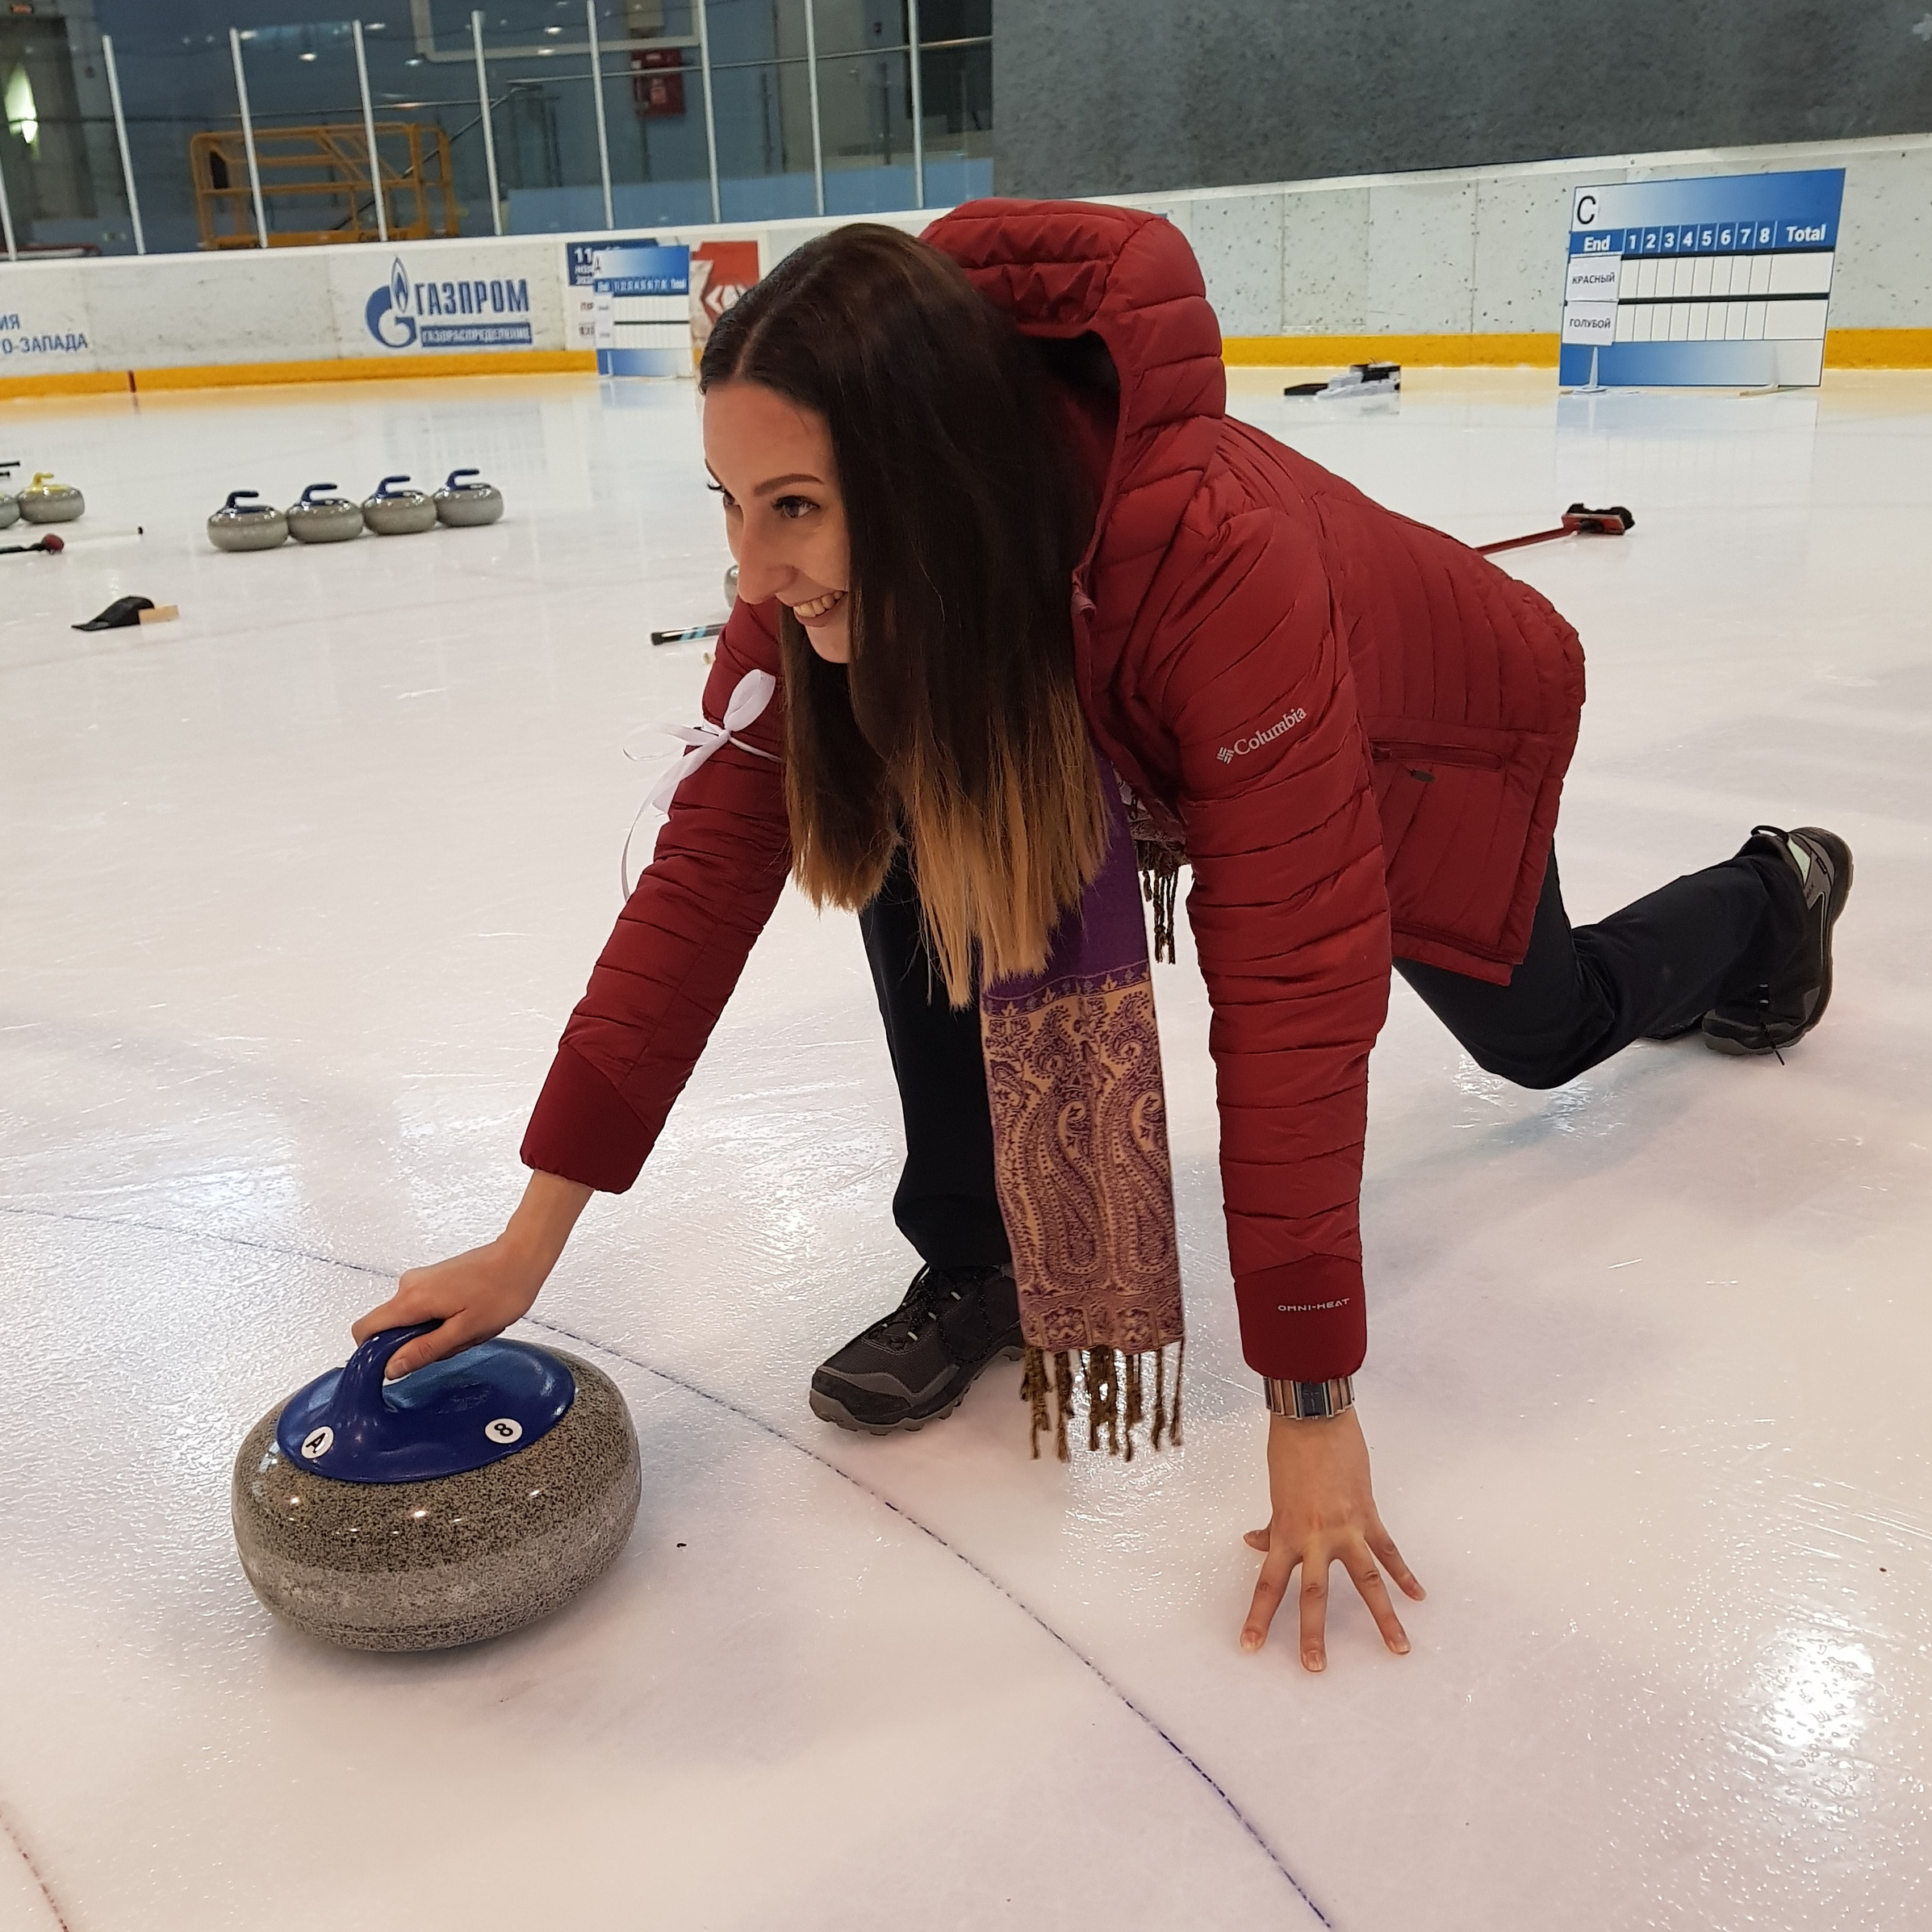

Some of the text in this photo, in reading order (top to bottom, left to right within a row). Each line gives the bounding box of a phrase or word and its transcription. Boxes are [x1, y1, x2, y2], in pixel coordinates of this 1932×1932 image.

[1577, 194, 1596, 225] C
[1583, 223, 1827, 253] End 1 2 3 4 5 6 7 8 Total
[1572, 272, 1615, 284] КРАСНЫЙ
[414, 278, 529, 316] ГАЗПРОМ
[1570, 318, 1611, 328] ГОЛУБОЙ
[1234, 707, 1307, 755] Columbia
[1278, 1298, 1350, 1311] OMNI-HEAT
[493, 1422, 514, 1437] 8
[305, 1432, 327, 1453] A
